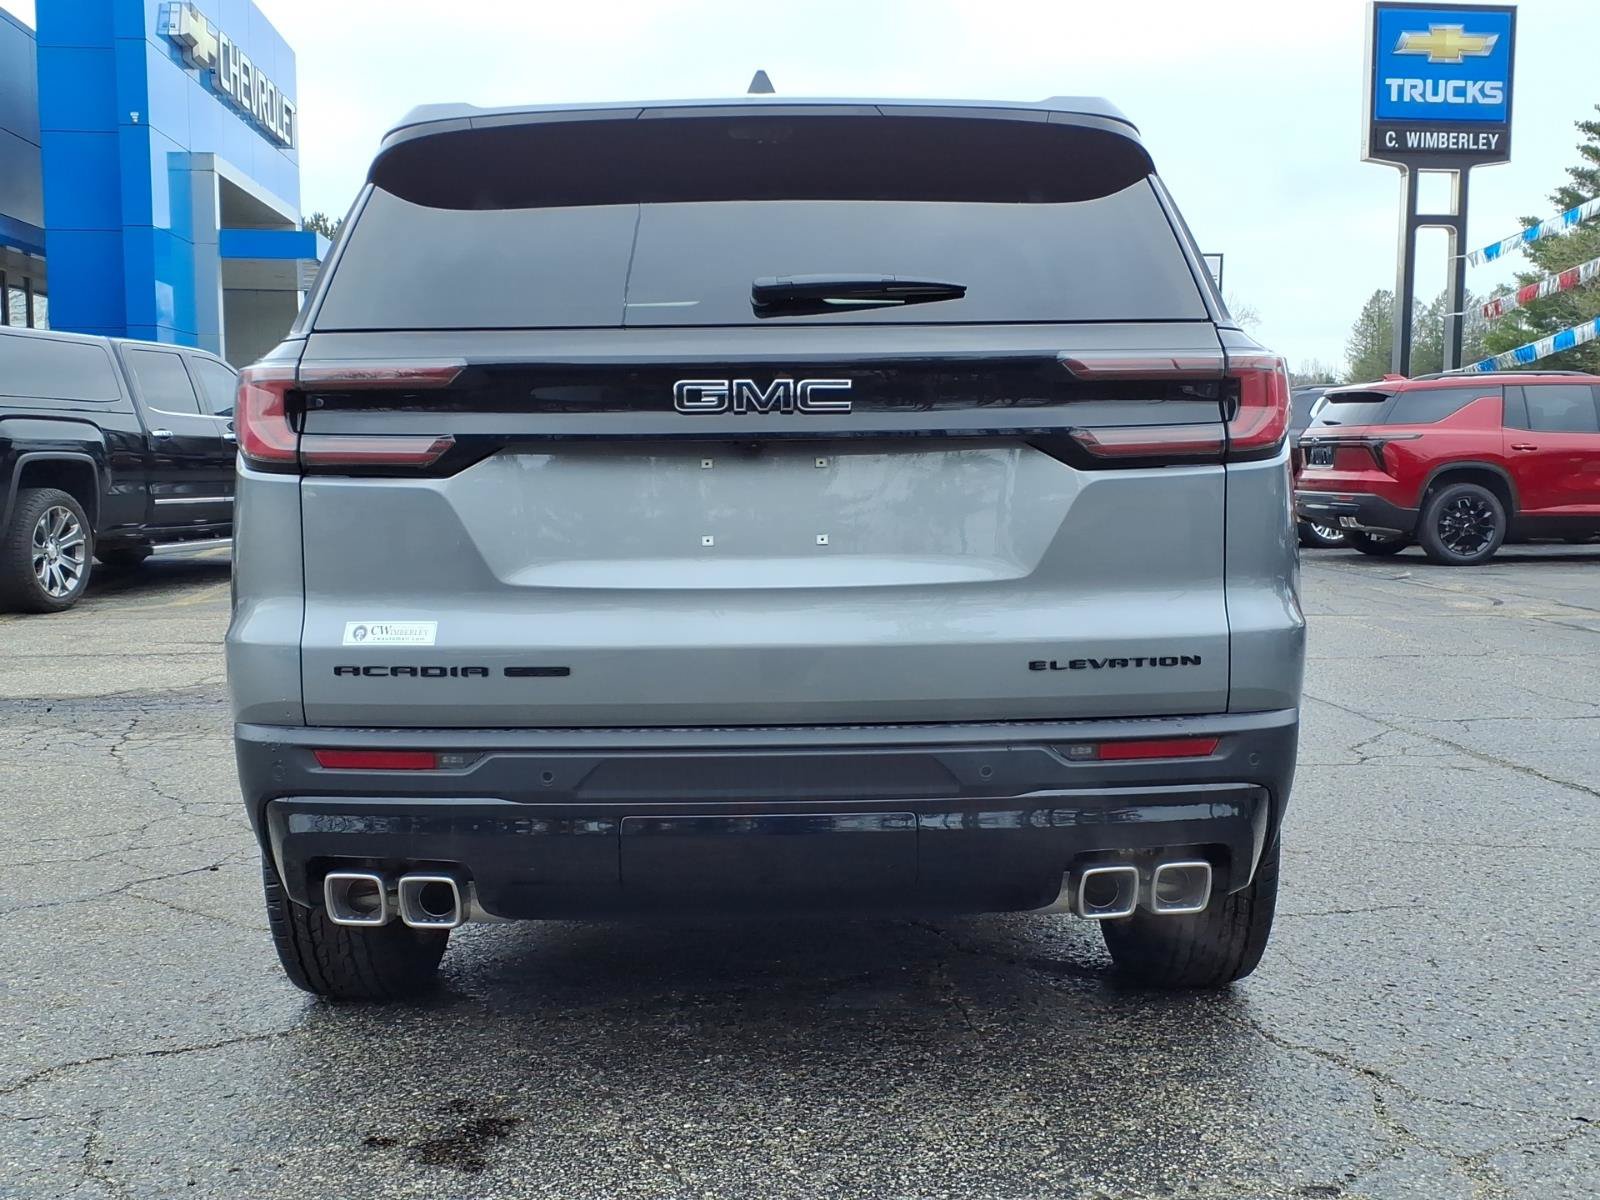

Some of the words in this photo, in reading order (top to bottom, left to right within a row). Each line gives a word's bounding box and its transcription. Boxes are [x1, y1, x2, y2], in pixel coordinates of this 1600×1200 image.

[218, 31, 297, 149] CHEVROLET
[1385, 78, 1504, 104] TRUCKS
[1385, 131, 1398, 148] C.
[1406, 132, 1499, 150] WIMBERLEY
[673, 379, 852, 414] GMC
[333, 665, 489, 677] ACADIA
[1028, 655, 1201, 671] ELEVATION
